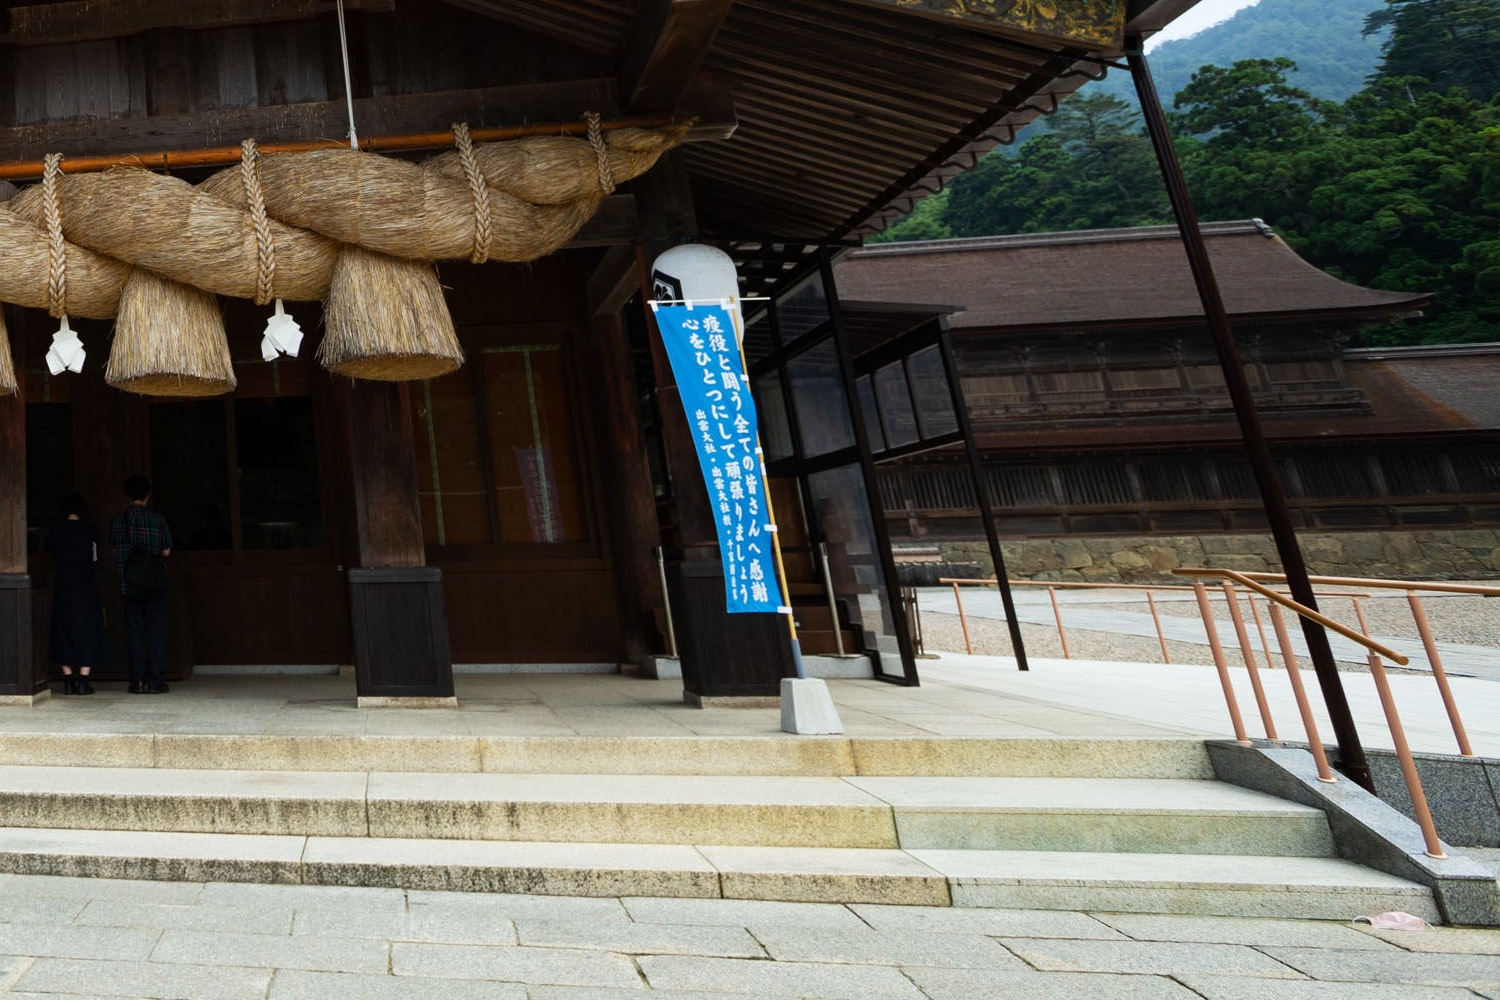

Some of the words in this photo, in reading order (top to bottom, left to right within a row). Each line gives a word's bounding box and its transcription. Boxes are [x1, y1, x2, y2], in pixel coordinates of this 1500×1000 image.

[682, 319, 748, 604] 心をひとつにして頑張りましょう
[702, 315, 768, 602] 疫役と闘う全ての皆さんへ感謝
